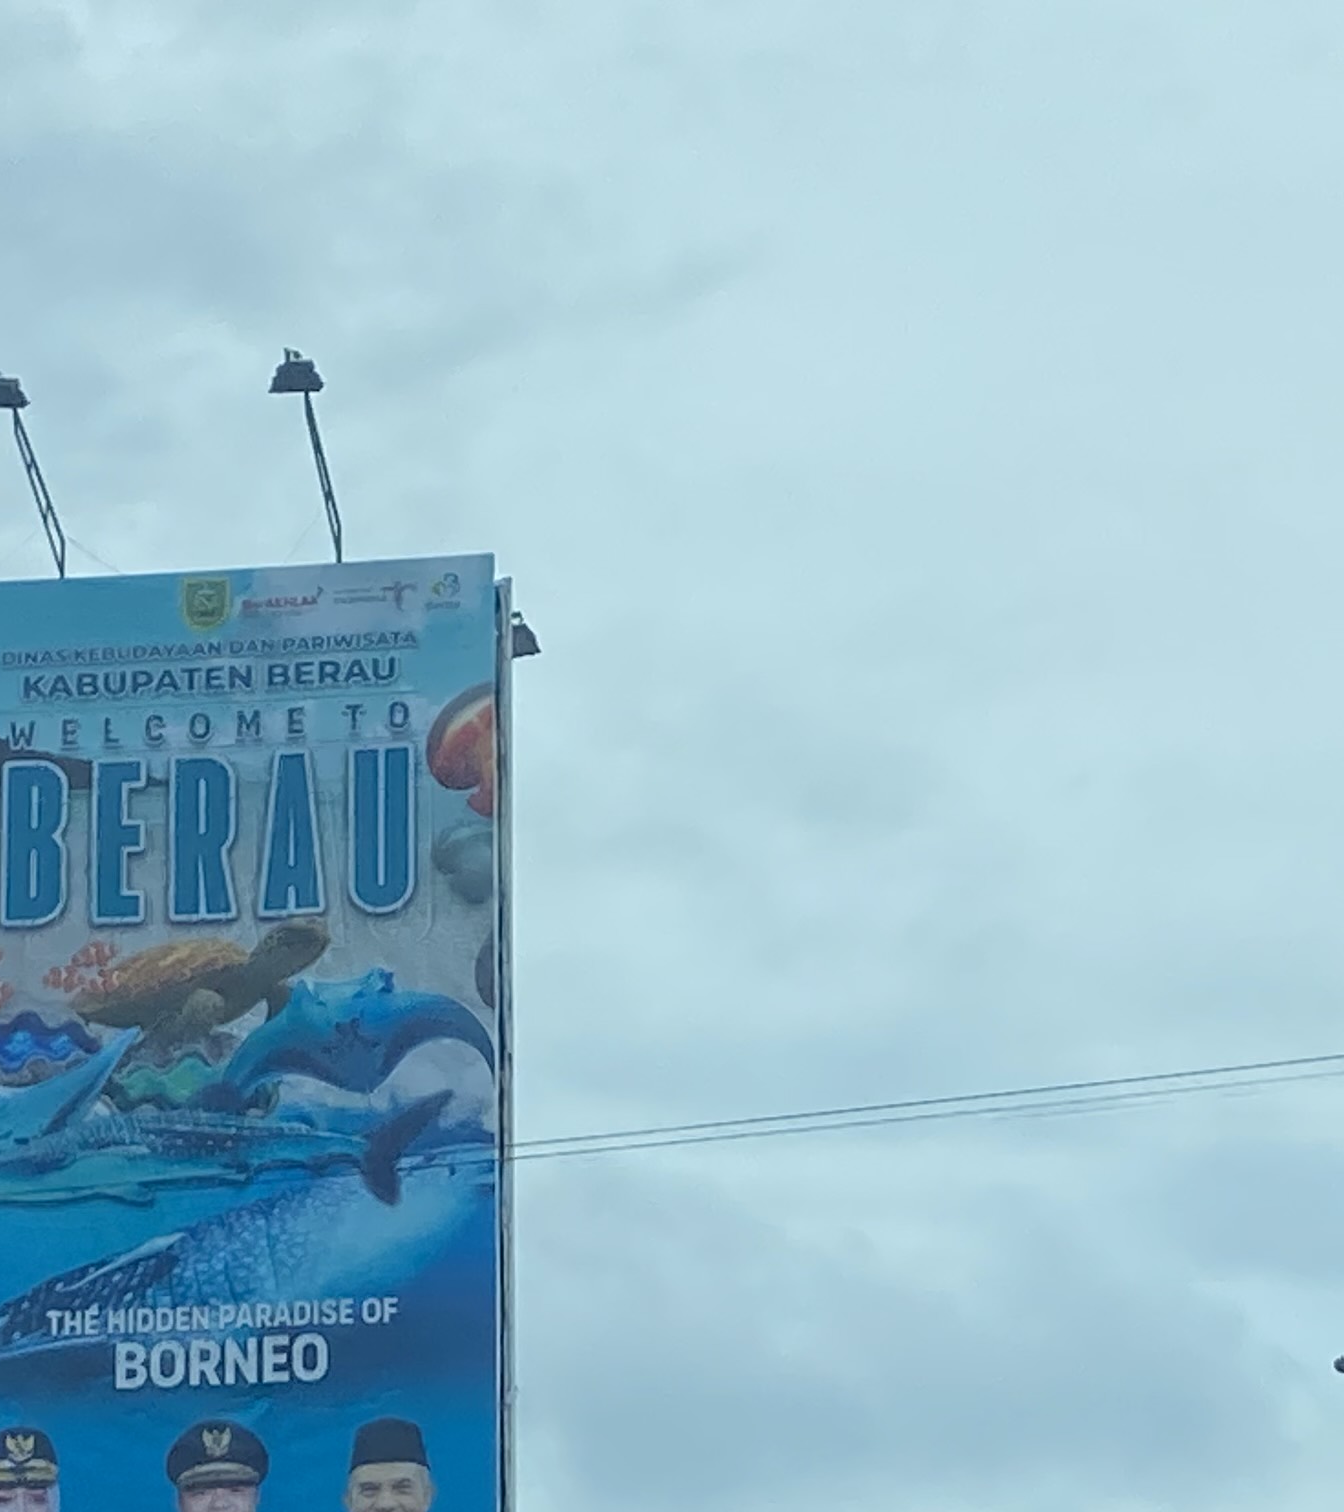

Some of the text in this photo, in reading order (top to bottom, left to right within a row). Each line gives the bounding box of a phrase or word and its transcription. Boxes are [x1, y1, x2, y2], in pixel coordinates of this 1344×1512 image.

[2, 631, 417, 667] DINAS KEBUDAYAAN DAN PARIWISATA
[22, 656, 398, 700] KABUPATEN BERAU
[8, 700, 411, 749] WELCOME TO
[1, 744, 418, 927] BERAU
[47, 1297, 398, 1334] THE HIDDEN PARADISE OF
[113, 1333, 329, 1390] BORNEO
